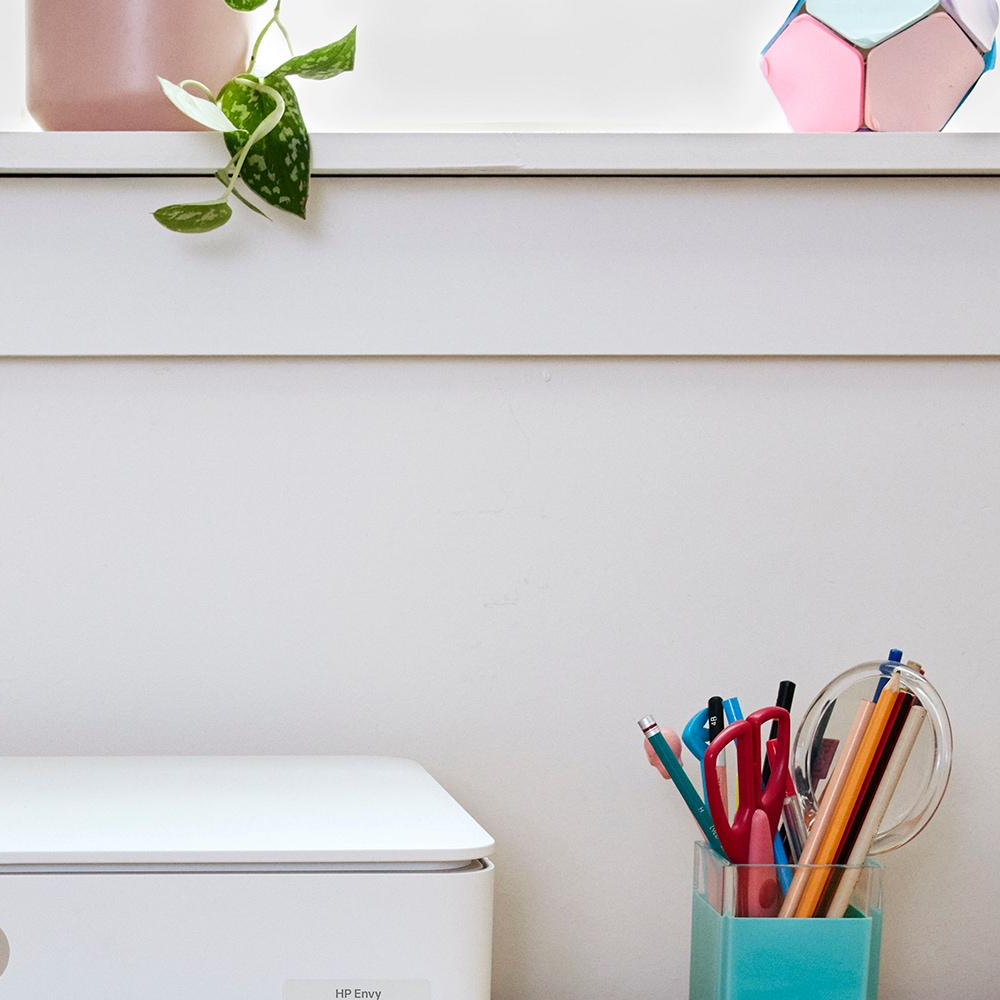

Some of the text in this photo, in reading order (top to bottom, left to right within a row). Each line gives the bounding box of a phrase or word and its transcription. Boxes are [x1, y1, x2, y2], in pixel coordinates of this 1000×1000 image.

[710, 716, 717, 726] 4B
[335, 988, 382, 1000] HP Envy
